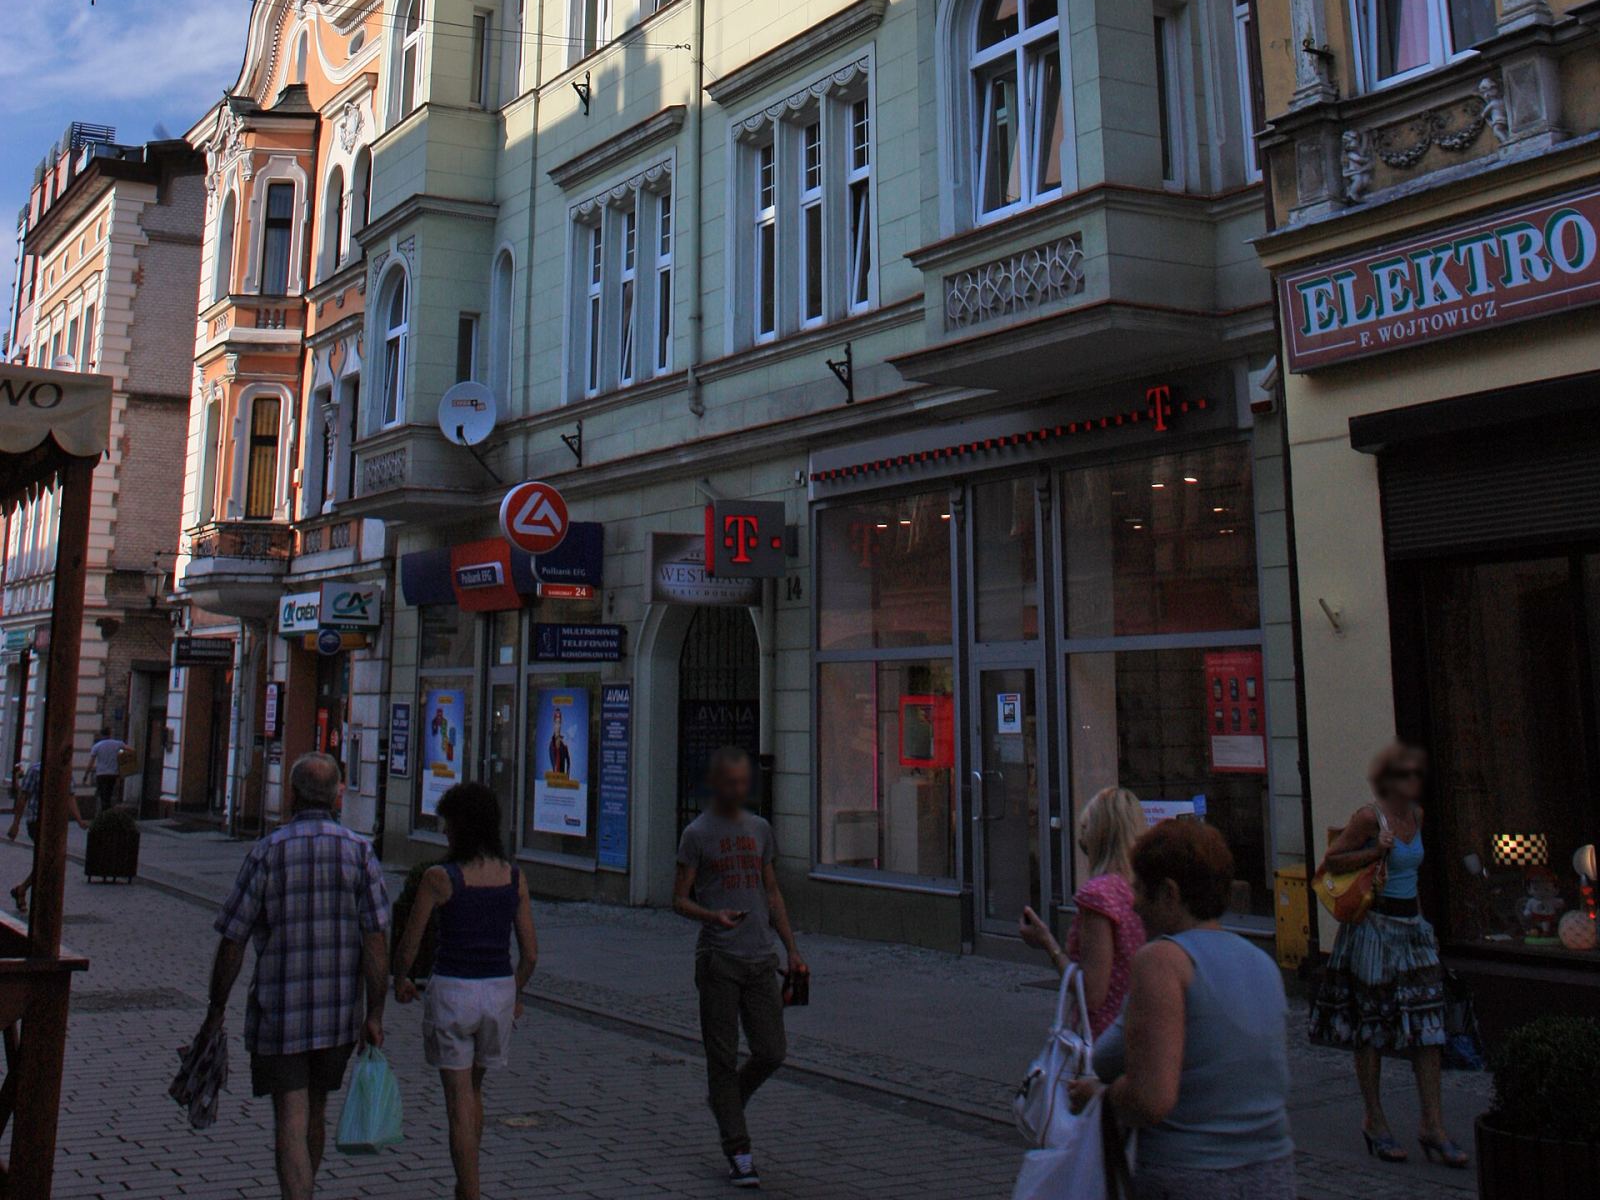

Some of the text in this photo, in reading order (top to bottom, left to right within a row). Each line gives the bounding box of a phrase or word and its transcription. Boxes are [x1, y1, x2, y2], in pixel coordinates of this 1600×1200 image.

[1297, 208, 1597, 337] ELEKTRO
[1360, 300, 1497, 348] F. WÓJTOWICZ
[725, 515, 759, 564] T
[542, 566, 571, 576] Polbank
[575, 587, 587, 597] 24
[786, 577, 803, 601] 14
[561, 638, 618, 647] TELEFONÓW
